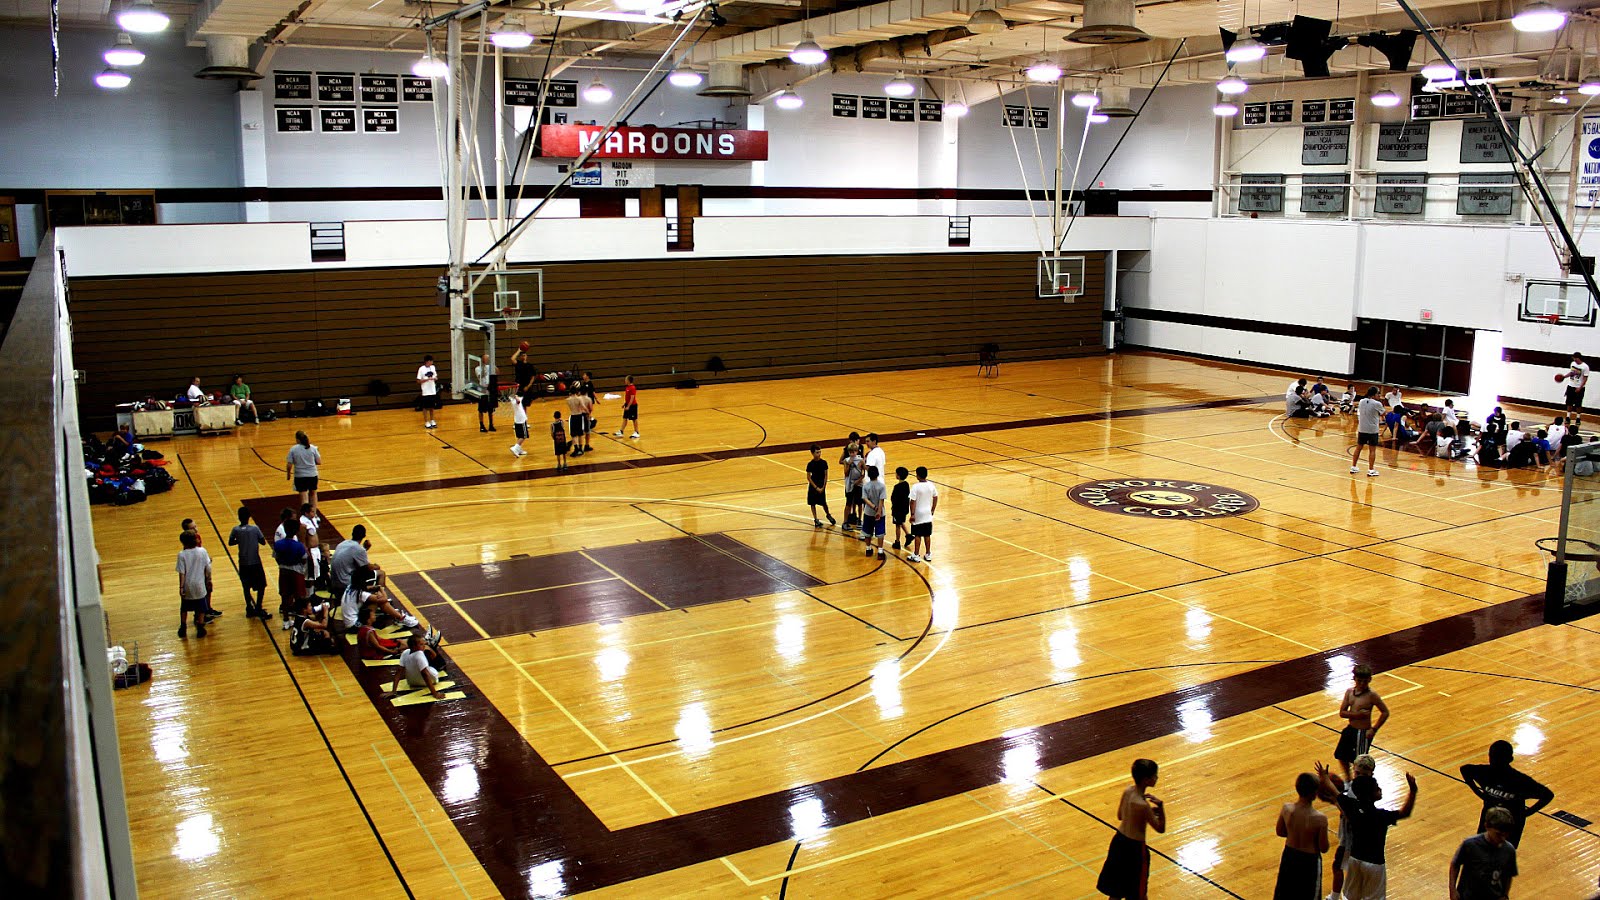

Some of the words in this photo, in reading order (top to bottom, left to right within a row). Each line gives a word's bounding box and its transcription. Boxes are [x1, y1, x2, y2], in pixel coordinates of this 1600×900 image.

[578, 130, 736, 155] MAROONS
[1475, 142, 1489, 150] FINAL
[1490, 142, 1503, 150] FOUR
[611, 161, 632, 169] MAROON
[616, 170, 627, 178] PIT
[572, 176, 601, 185] PEPSI
[614, 179, 629, 187] STOP
[1079, 480, 1210, 507] ROANOKE
[1123, 492, 1248, 518] COLLEGE
